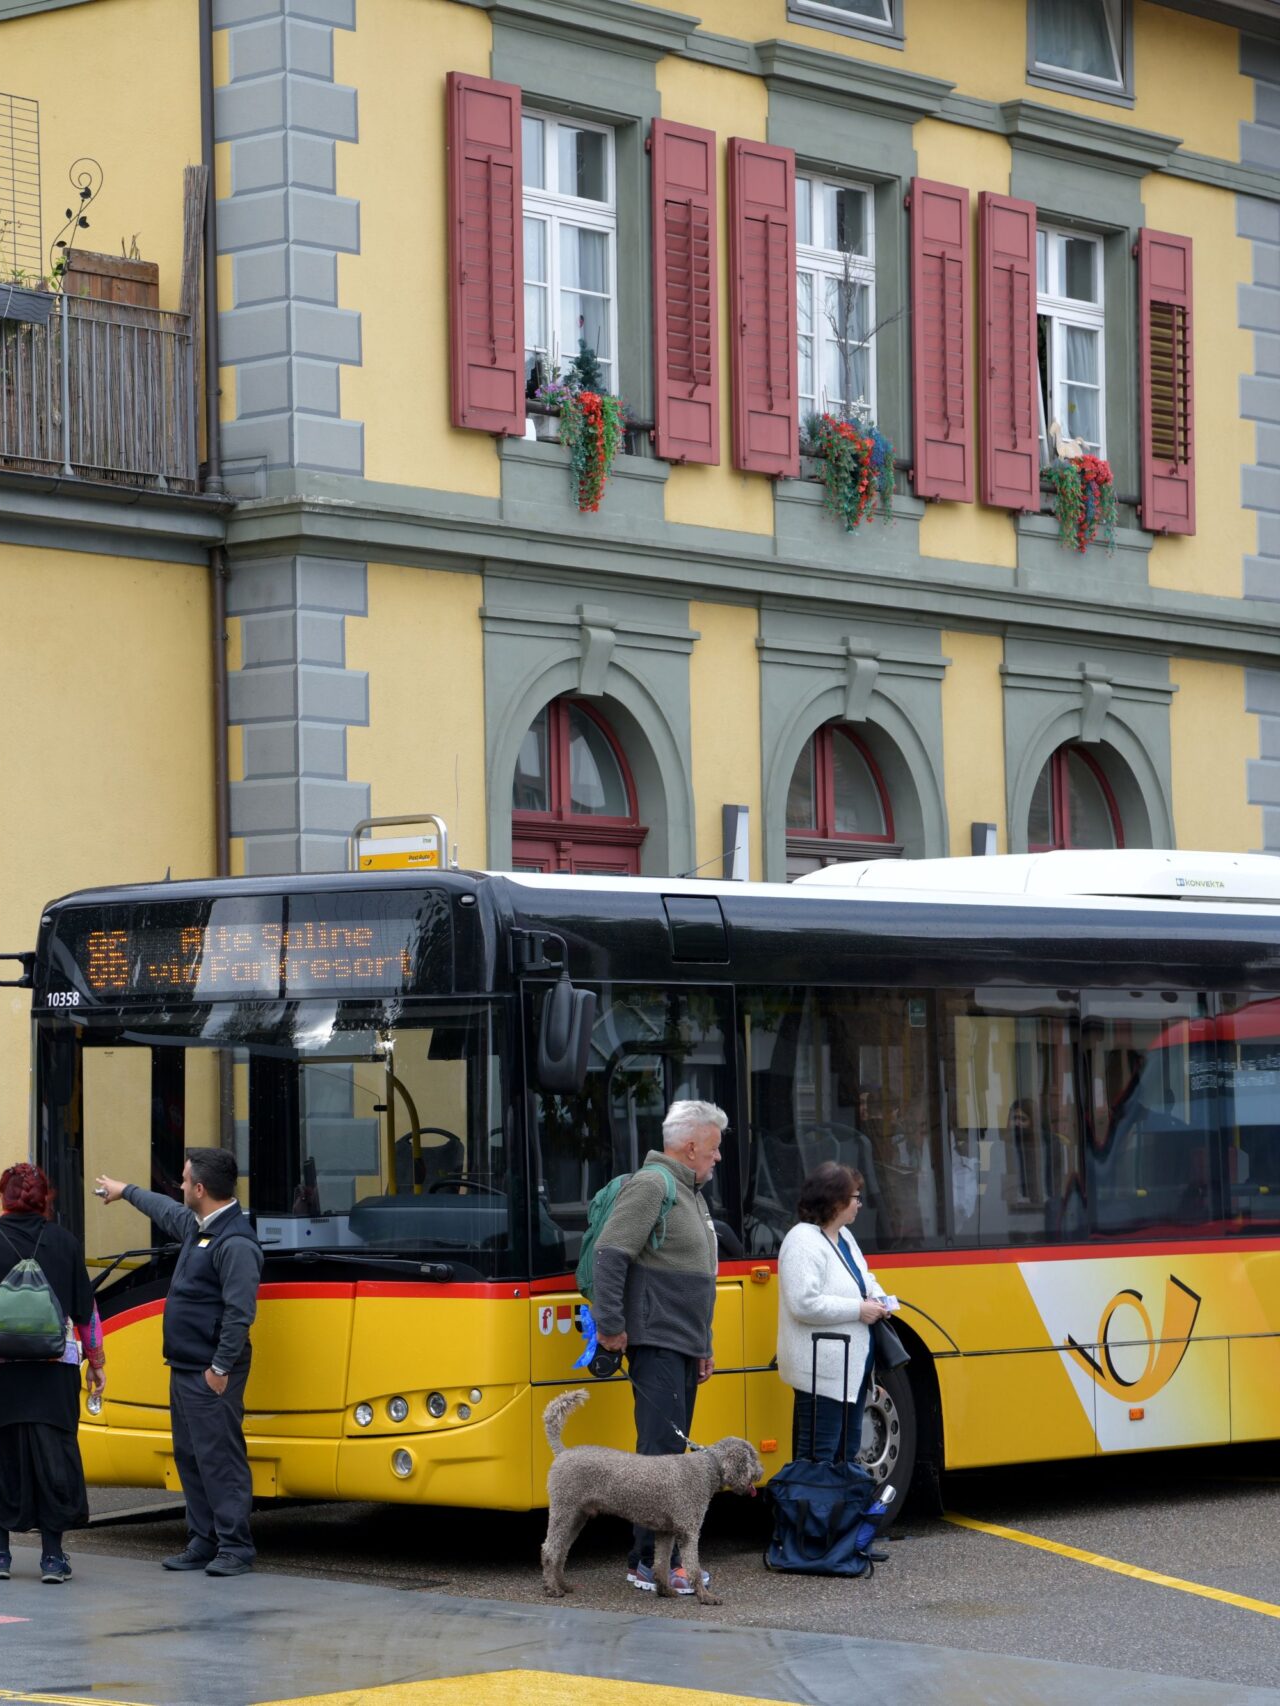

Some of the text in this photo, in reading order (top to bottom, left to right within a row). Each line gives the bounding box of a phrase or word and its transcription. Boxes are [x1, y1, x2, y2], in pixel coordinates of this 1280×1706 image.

[1185, 879, 1225, 888] KONVEKTA
[181, 926, 252, 953] Alte
[261, 921, 373, 950] Saline
[149, 948, 413, 983] via Parkresort
[47, 991, 80, 1007] 10358
